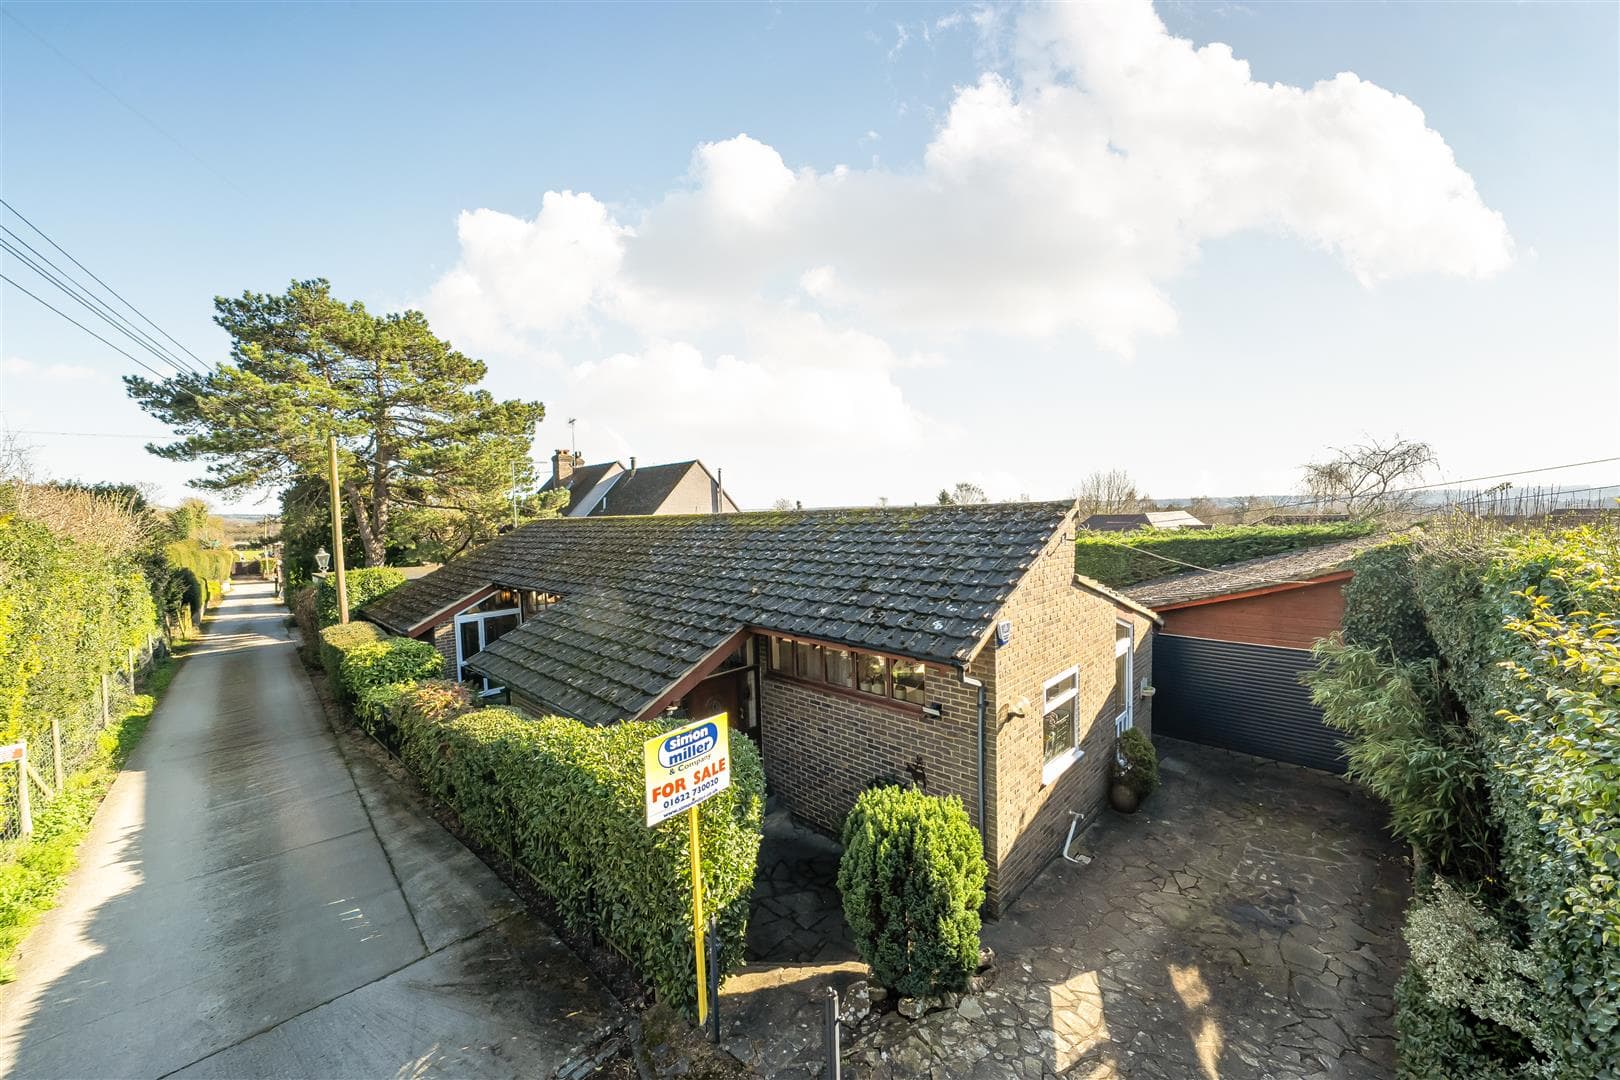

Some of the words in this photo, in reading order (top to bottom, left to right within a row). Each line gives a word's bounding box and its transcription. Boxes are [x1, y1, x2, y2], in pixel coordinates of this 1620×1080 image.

[669, 727, 708, 749] simon
[668, 740, 710, 765] miller
[669, 767, 675, 775] &
[678, 754, 711, 772] Company
[652, 777, 686, 803] FOR
[693, 758, 726, 785] SALE
[663, 792, 690, 808] 01622
